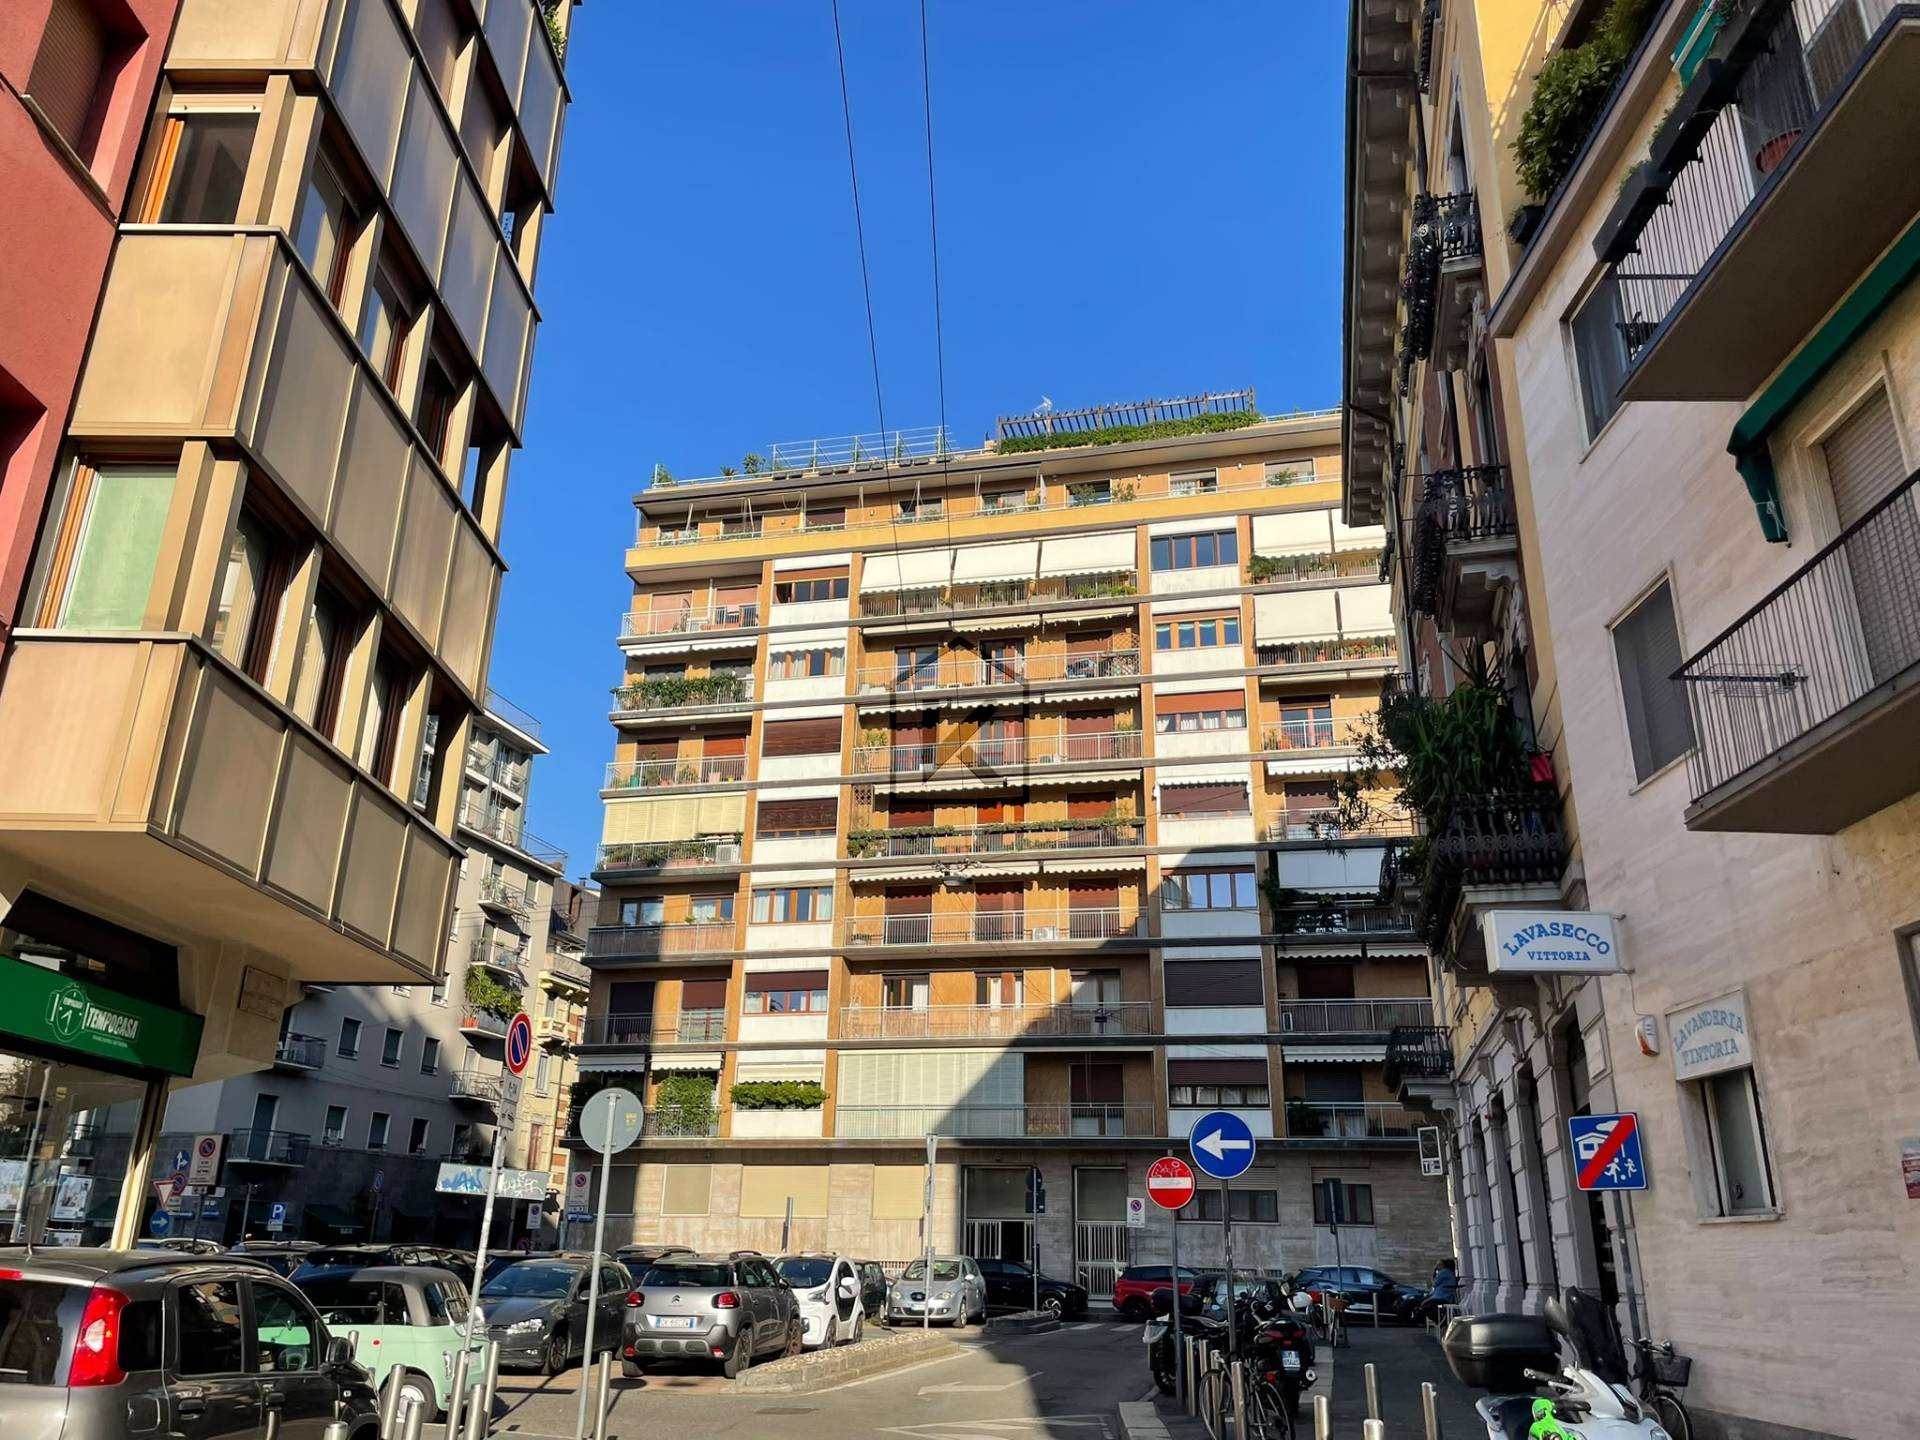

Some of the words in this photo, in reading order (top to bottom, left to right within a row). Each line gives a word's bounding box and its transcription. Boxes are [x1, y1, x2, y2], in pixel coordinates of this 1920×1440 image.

[1503, 922, 1610, 956] LAVASECCO
[1527, 951, 1592, 961] VITTORIA
[86, 1007, 139, 1039] TEMPOCASA
[1673, 1009, 1745, 1052] LAVANDERIA
[1681, 1037, 1740, 1066] TINTORIA
[271, 1204, 283, 1218] P
